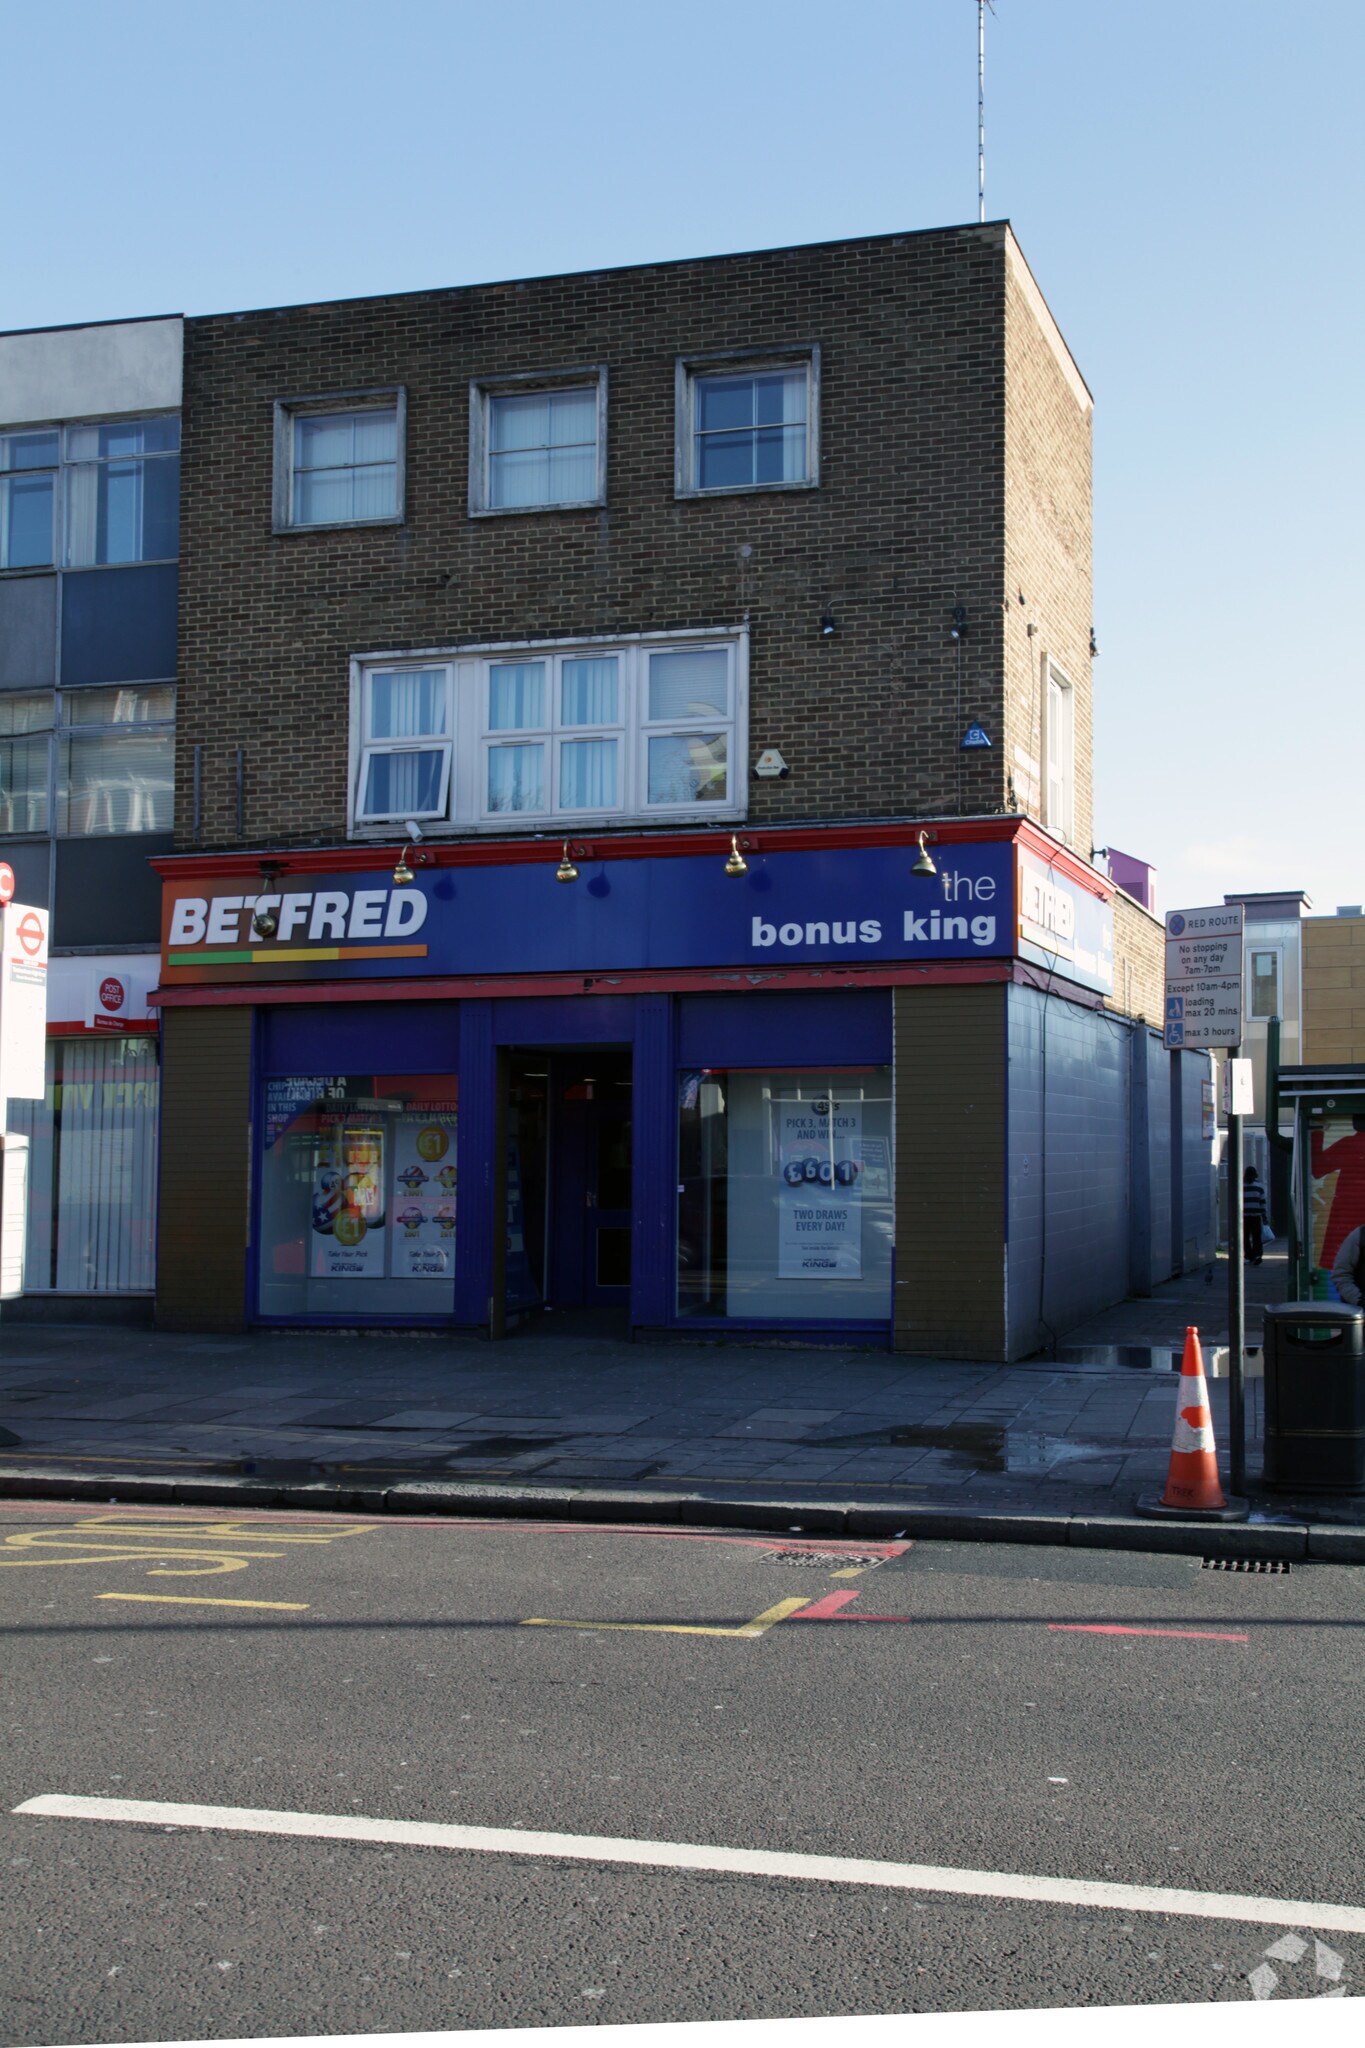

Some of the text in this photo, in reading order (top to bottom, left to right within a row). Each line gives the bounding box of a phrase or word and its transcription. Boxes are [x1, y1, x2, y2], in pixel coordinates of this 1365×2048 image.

[941, 871, 997, 902] the
[168, 888, 428, 946] BETFRED
[1188, 915, 1239, 928] RED ROUTE
[751, 910, 997, 947] bonus king
[1179, 942, 1228, 953] No stopping
[1193, 955, 1207, 964] any
[1210, 952, 1224, 963] day
[1184, 965, 1221, 975] 7am-7pm
[105, 984, 120, 994] POST
[1167, 981, 1239, 993] Except 10am-4pm
[101, 992, 122, 1004] OFFICE
[1185, 998, 1215, 1008] loading
[1185, 1006, 1238, 1017] max 20 mins
[1185, 1027, 1235, 1037] max 3 hours
[267, 1102, 297, 1112] IN THIS
[267, 1113, 289, 1123] SHOP
[786, 1118, 807, 1129] PICK
[808, 1118, 817, 1130] 3,
[850, 1117, 856, 1128] 3
[797, 1129, 816, 1140] AND
[787, 1161, 851, 1183] £601
[793, 1209, 848, 1220] TWO DRAWS
[796, 1221, 845, 1232] EVERY DAY!
[436, 1250, 449, 1258] Pk
[1171, 1486, 1194, 1498] TREK
